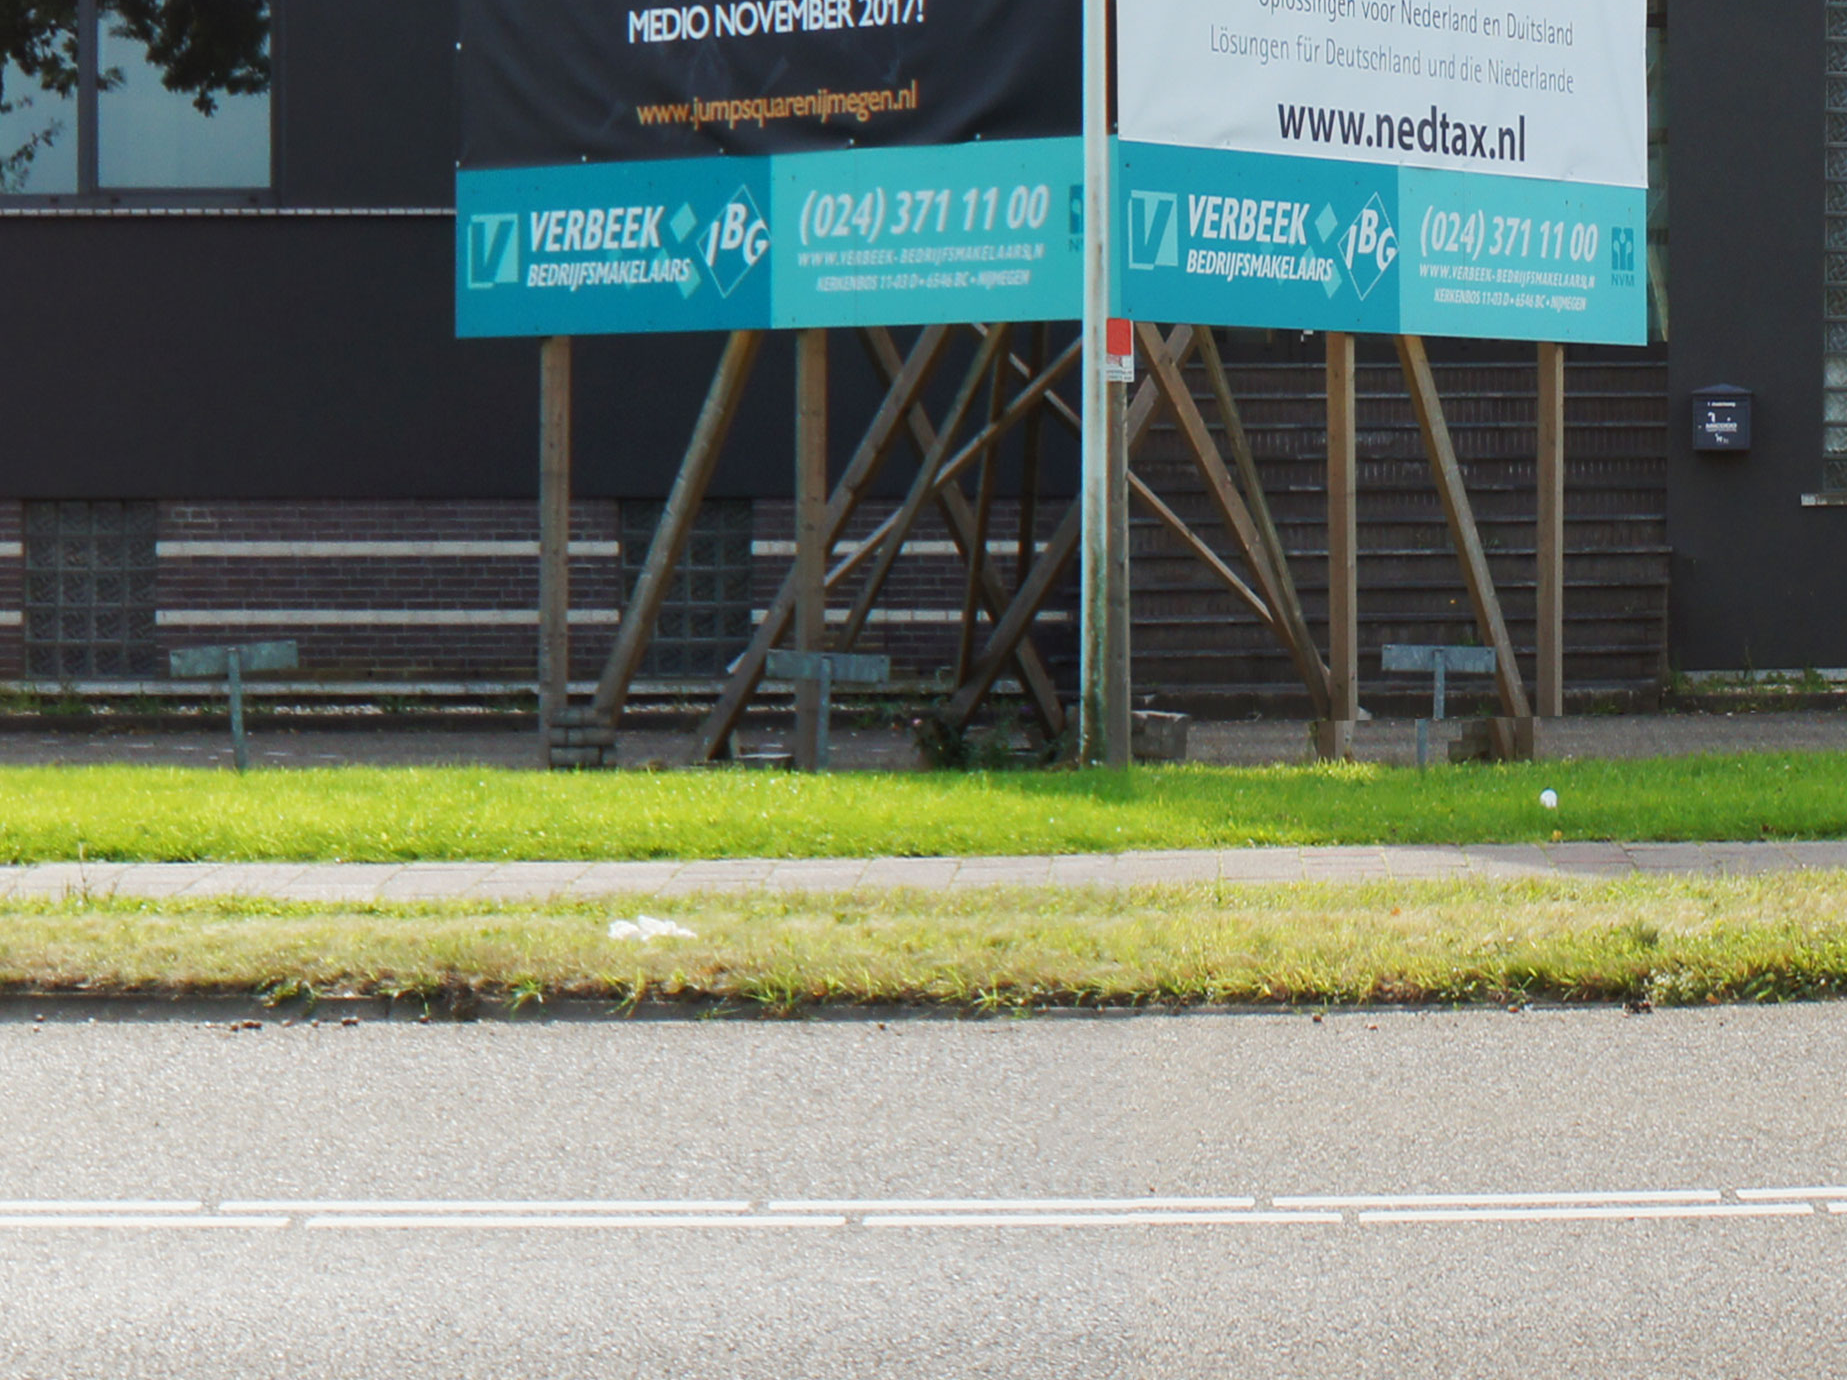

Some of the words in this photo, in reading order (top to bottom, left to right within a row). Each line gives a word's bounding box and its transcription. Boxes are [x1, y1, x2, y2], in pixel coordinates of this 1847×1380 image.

[628, 5, 710, 44] MEDIO
[1362, 0, 1396, 24] voor
[1482, 15, 1501, 37] en
[1506, 13, 1574, 48] Duitsland
[1210, 24, 1290, 66] Lösungen
[1295, 34, 1320, 64] für
[1325, 38, 1422, 77] Deutschland
[1427, 54, 1456, 81] und
[1460, 56, 1483, 83] die
[1487, 58, 1575, 95] Niederlande
[636, 78, 918, 132] www.jumpsquarenijmegen.nl
[1277, 102, 1527, 163] www.nedtax.nl
[530, 205, 665, 253] VERBEEK
[799, 186, 887, 247] (024)
[890, 189, 952, 235] 371
[962, 187, 1000, 232] 11
[1007, 184, 1050, 230] 00
[1188, 194, 1311, 246] VERBEEK
[1420, 205, 1486, 261] (024)
[1489, 216, 1533, 257] 371
[1540, 220, 1565, 260] 11
[1569, 222, 1600, 262] 00
[526, 257, 693, 293] BEDRIJFSMAKELAARS
[1186, 249, 1334, 283] BEDRIJFSMAKELAARS
[1610, 273, 1635, 287] NVM
